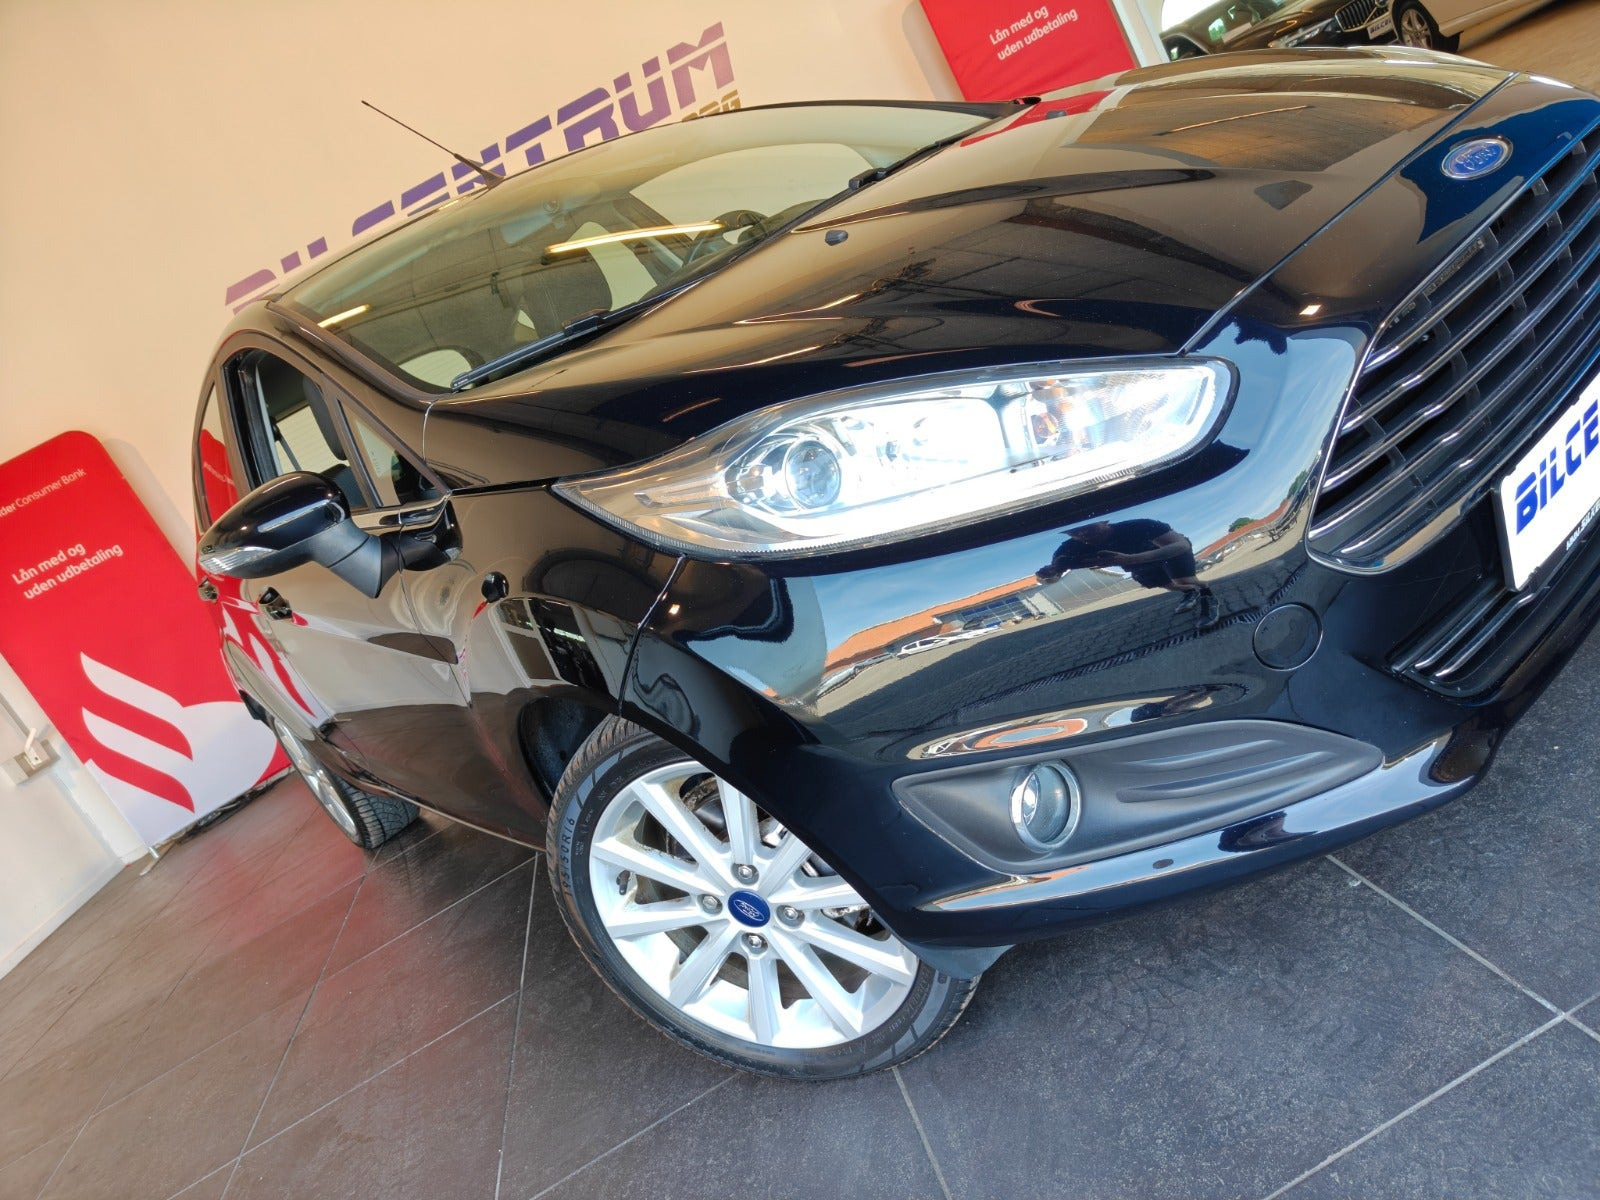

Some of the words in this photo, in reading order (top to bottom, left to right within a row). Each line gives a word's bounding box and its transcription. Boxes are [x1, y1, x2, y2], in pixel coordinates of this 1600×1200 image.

[989, 28, 1010, 45] Lån
[1010, 11, 1034, 33] med
[1034, 5, 1049, 19] og
[997, 40, 1024, 60] uden
[1023, 8, 1078, 45] udbetaling
[15, 479, 62, 508] Consumer
[60, 468, 87, 485] Bank
[11, 568, 39, 584] Lån
[37, 549, 67, 572] med
[67, 543, 86, 557] og
[23, 578, 57, 599] uden
[57, 544, 124, 582] udbetaling
